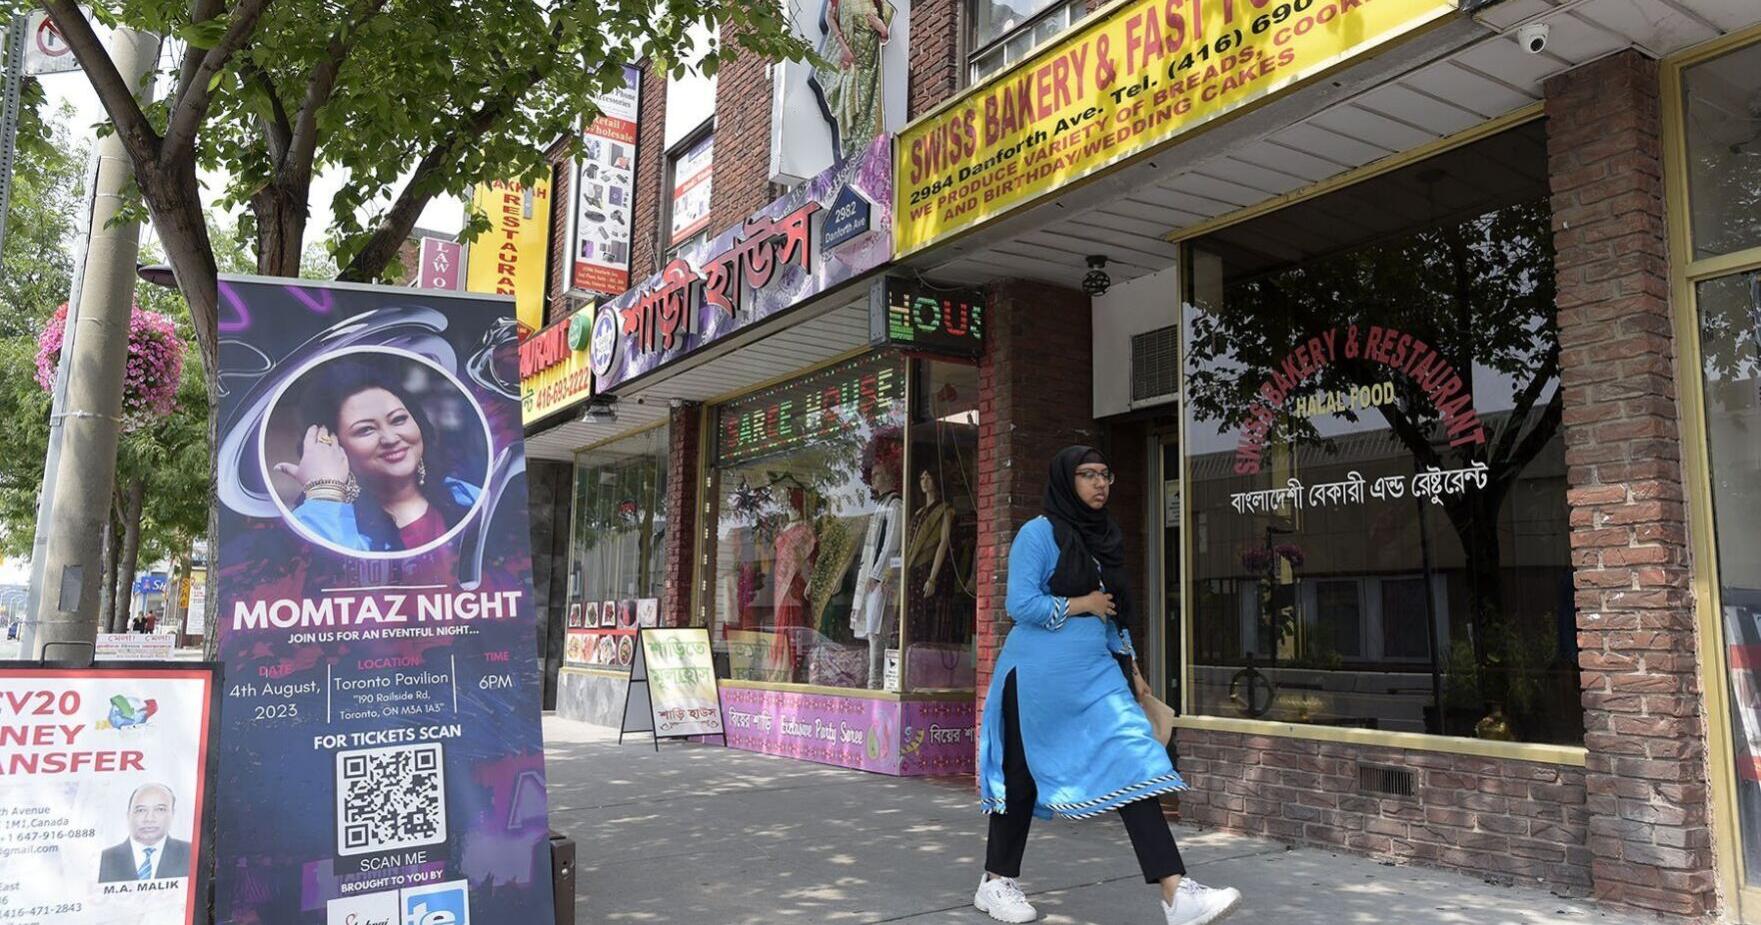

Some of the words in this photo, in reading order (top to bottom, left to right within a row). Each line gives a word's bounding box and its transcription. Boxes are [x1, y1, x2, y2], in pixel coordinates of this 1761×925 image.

[910, 108, 977, 185] SWISS
[985, 41, 1089, 147] BAKERY
[1095, 33, 1117, 91] &
[1125, 0, 1203, 76] FAST
[910, 174, 954, 206] 2984
[959, 130, 1047, 183] Danforth
[1054, 107, 1103, 136] Ave.
[1111, 75, 1158, 104] Tel.
[1168, 29, 1243, 79] (416)
[910, 203, 933, 222] WE
[938, 164, 1018, 209] PRODUCE
[1024, 115, 1109, 168] VARIETY
[1116, 100, 1145, 123] OF
[1153, 45, 1263, 107] BREADS,
[944, 197, 978, 222] AND
[984, 98, 1192, 206] BIRTHDAY/WEDDING
[1201, 47, 1295, 102] CAKES
[835, 201, 856, 223] 2982
[825, 224, 852, 243] Danforth
[702, 201, 822, 318] হাউস
[536, 366, 589, 411] 416-693-2222
[806, 368, 894, 429] HOUSE
[1296, 388, 1346, 418] HALAL
[1350, 381, 1395, 411] FOOD
[1234, 403, 1273, 475] SWISS
[1260, 328, 1336, 406] BAKERY
[1345, 325, 1359, 358] &
[1365, 326, 1485, 447] RESTAURANT
[1230, 478, 1304, 514] বাংলাদেশী
[1309, 471, 1366, 506] বেকারী
[1370, 475, 1405, 500] এন্ড
[232, 594, 408, 630] MOMTAZ
[418, 591, 522, 622] NIGHT
[288, 634, 316, 644] JOIN
[318, 632, 334, 642] US
[337, 631, 360, 641] FOR
[362, 629, 379, 639] AN
[382, 627, 434, 639] EVENTFUL
[436, 625, 479, 636] NIGHT...
[357, 656, 420, 670] LOCATION
[484, 651, 510, 662] TIME
[258, 664, 293, 677] DATE
[334, 676, 391, 691] Toronto
[395, 671, 449, 685] Pavilion
[229, 683, 256, 698] 4th
[262, 681, 320, 698] August,
[479, 675, 513, 689] 6PM
[255, 704, 298, 720] 2023
[340, 708, 380, 720] Toronto,
[383, 706, 398, 716] ON
[314, 735, 347, 750] FOR
[352, 728, 415, 746] TICKETS
[419, 724, 461, 740] SCAN
[815, 718, 837, 745] Party
[11, 806, 51, 815] Avenue
[17, 828, 96, 842] 647-916-0888
[360, 856, 400, 871] SCAN
[405, 851, 427, 865] ME
[103, 885, 132, 895] M.A.
[137, 880, 179, 892] MALIK
[341, 878, 389, 893] BROUGHT
[391, 876, 404, 885] TO
[407, 872, 428, 883] YOU
[430, 870, 443, 880] BY
